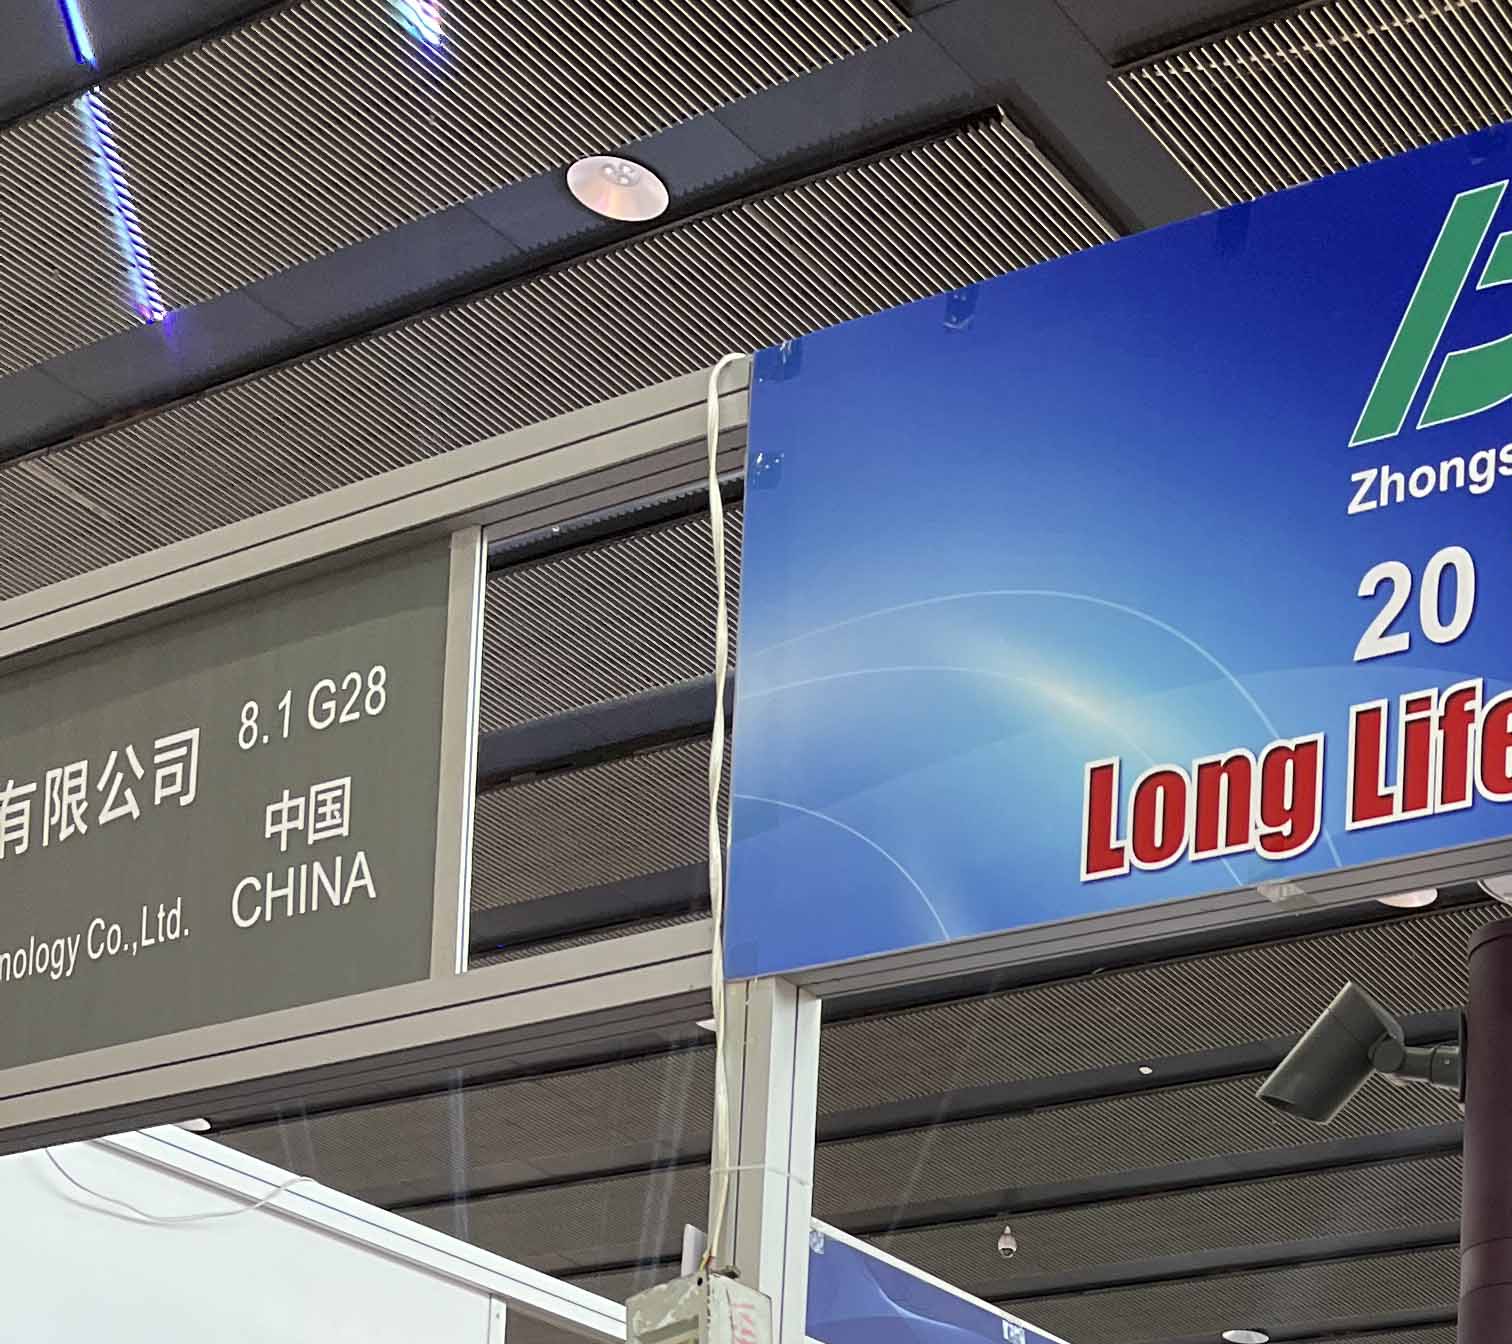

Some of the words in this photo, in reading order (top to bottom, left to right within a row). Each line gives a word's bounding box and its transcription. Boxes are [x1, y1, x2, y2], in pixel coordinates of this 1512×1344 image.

[1353, 545, 1476, 663] 20
[238, 690, 292, 750] 8.1
[308, 665, 386, 730] G28
[0, 727, 200, 860] 有限公司
[264, 776, 352, 852] 中国
[1080, 733, 1324, 883] Long
[87, 897, 190, 960] Co.,Ltd.
[231, 850, 376, 928] CHINA
